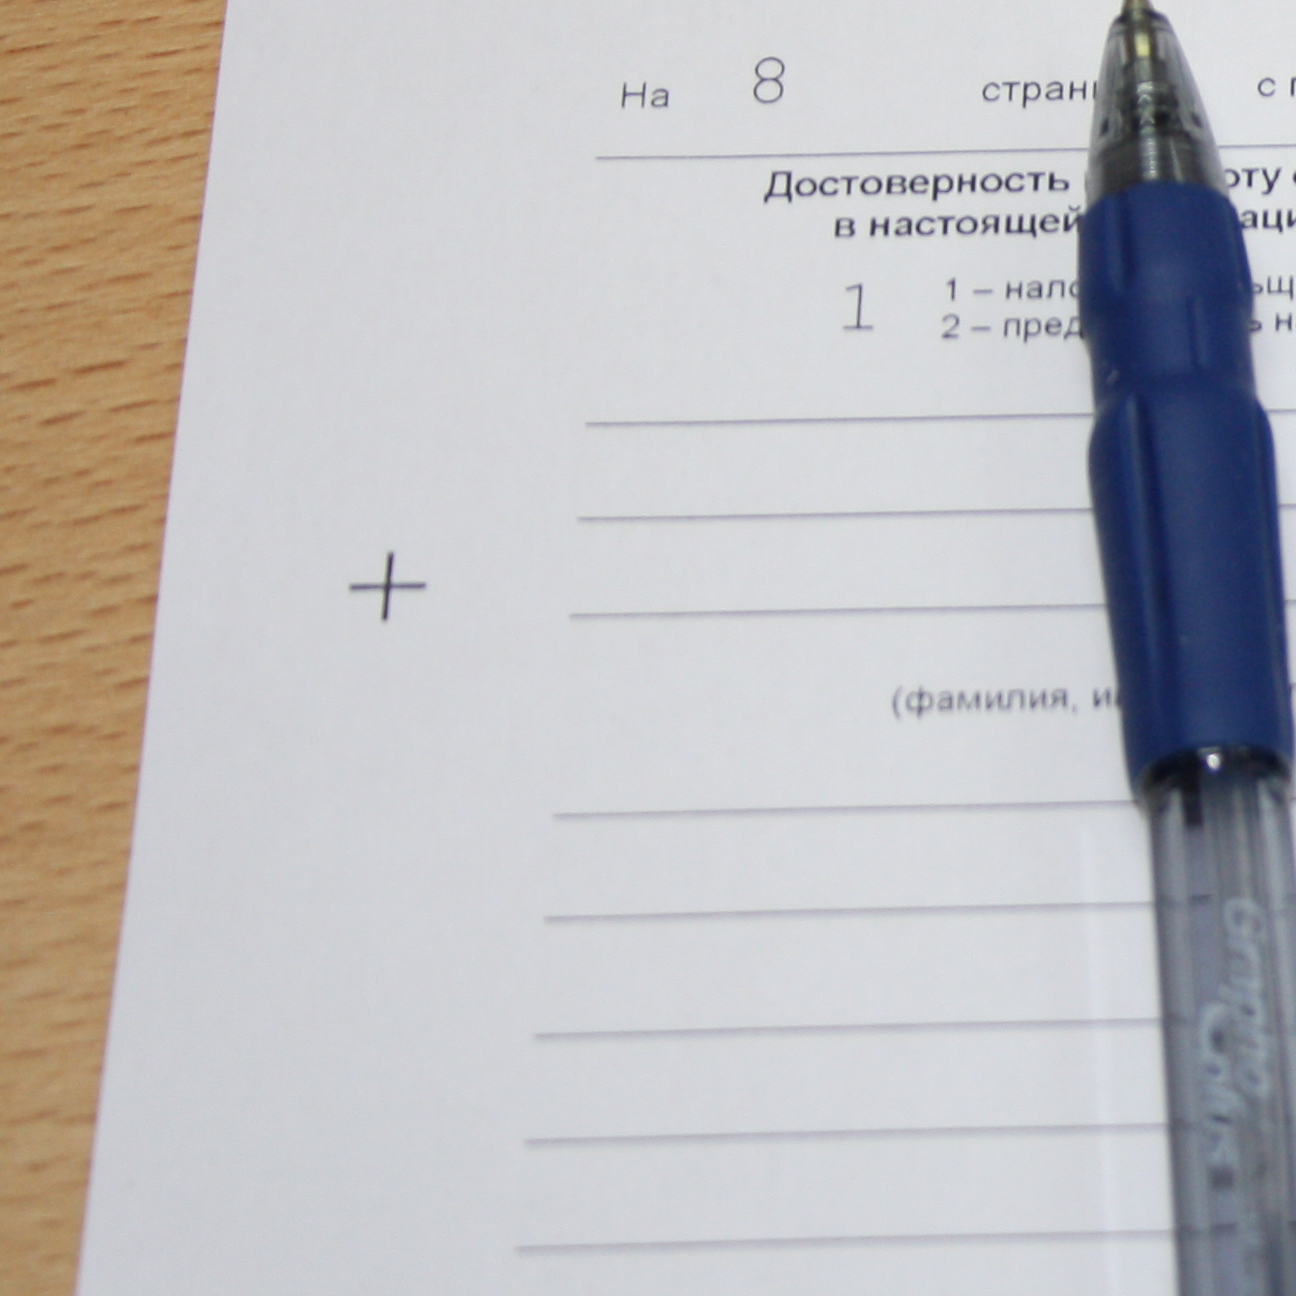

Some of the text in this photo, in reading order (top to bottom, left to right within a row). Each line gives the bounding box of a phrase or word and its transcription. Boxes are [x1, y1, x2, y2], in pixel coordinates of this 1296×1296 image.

[620, 81, 670, 109] На
[752, 56, 786, 105] 8
[1256, 76, 1276, 98] с
[763, 170, 1070, 204] Достоверность
[834, 217, 856, 238] в
[946, 277, 957, 302] 1
[843, 283, 873, 331] 1
[941, 313, 961, 340] 2
